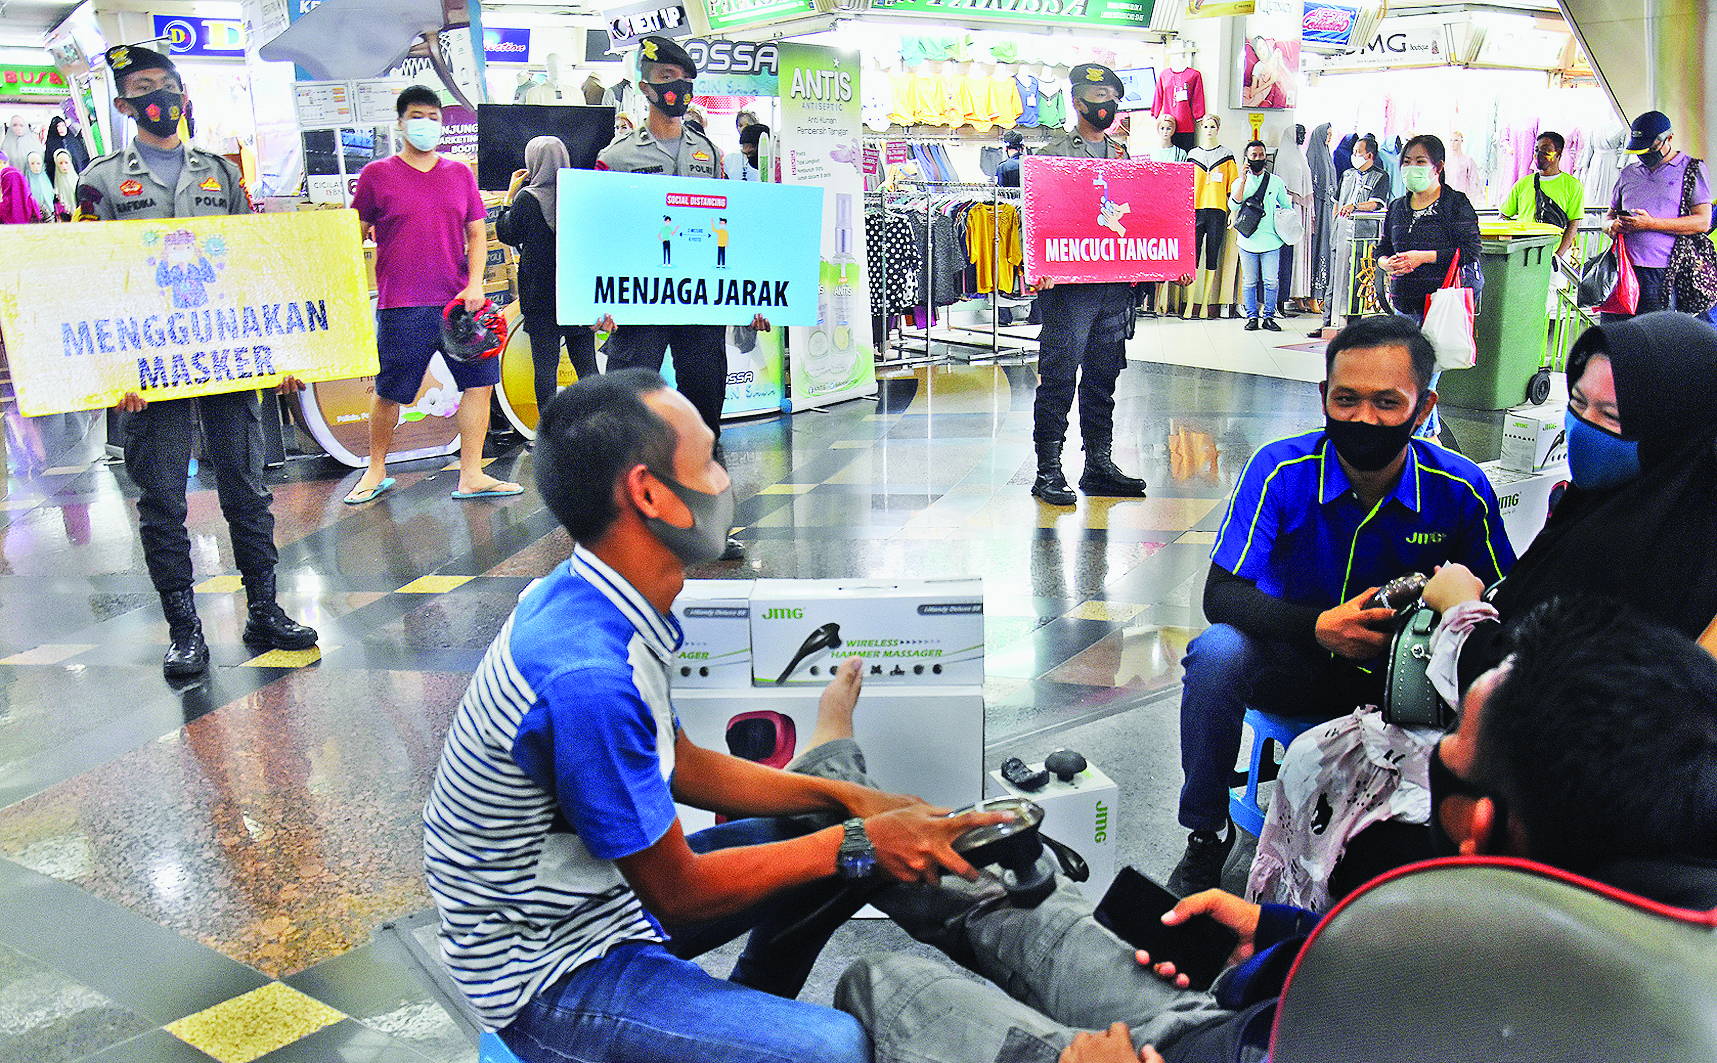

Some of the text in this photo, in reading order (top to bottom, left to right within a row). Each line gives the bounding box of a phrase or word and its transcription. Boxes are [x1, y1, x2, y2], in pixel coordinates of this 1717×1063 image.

[791, 67, 852, 102] ANTIS
[802, 102, 843, 111] ANTISEPTIC
[689, 165, 713, 177] POLRI
[194, 196, 228, 208] POLRI
[667, 195, 726, 207] SOCIAL DISTANCING
[1045, 238, 1179, 262] MENCUCI TANGAN
[594, 275, 789, 307] MENJAGA JARAK
[833, 286, 852, 297] ANTIS
[60, 299, 329, 357] MENGGUNAKAN
[137, 345, 276, 391] MASKER
[762, 608, 803, 620] JMG
[846, 639, 899, 648] WIRELESS
[831, 649, 942, 658] HAMMER MASSAGER
[1095, 800, 1107, 843] JMG
